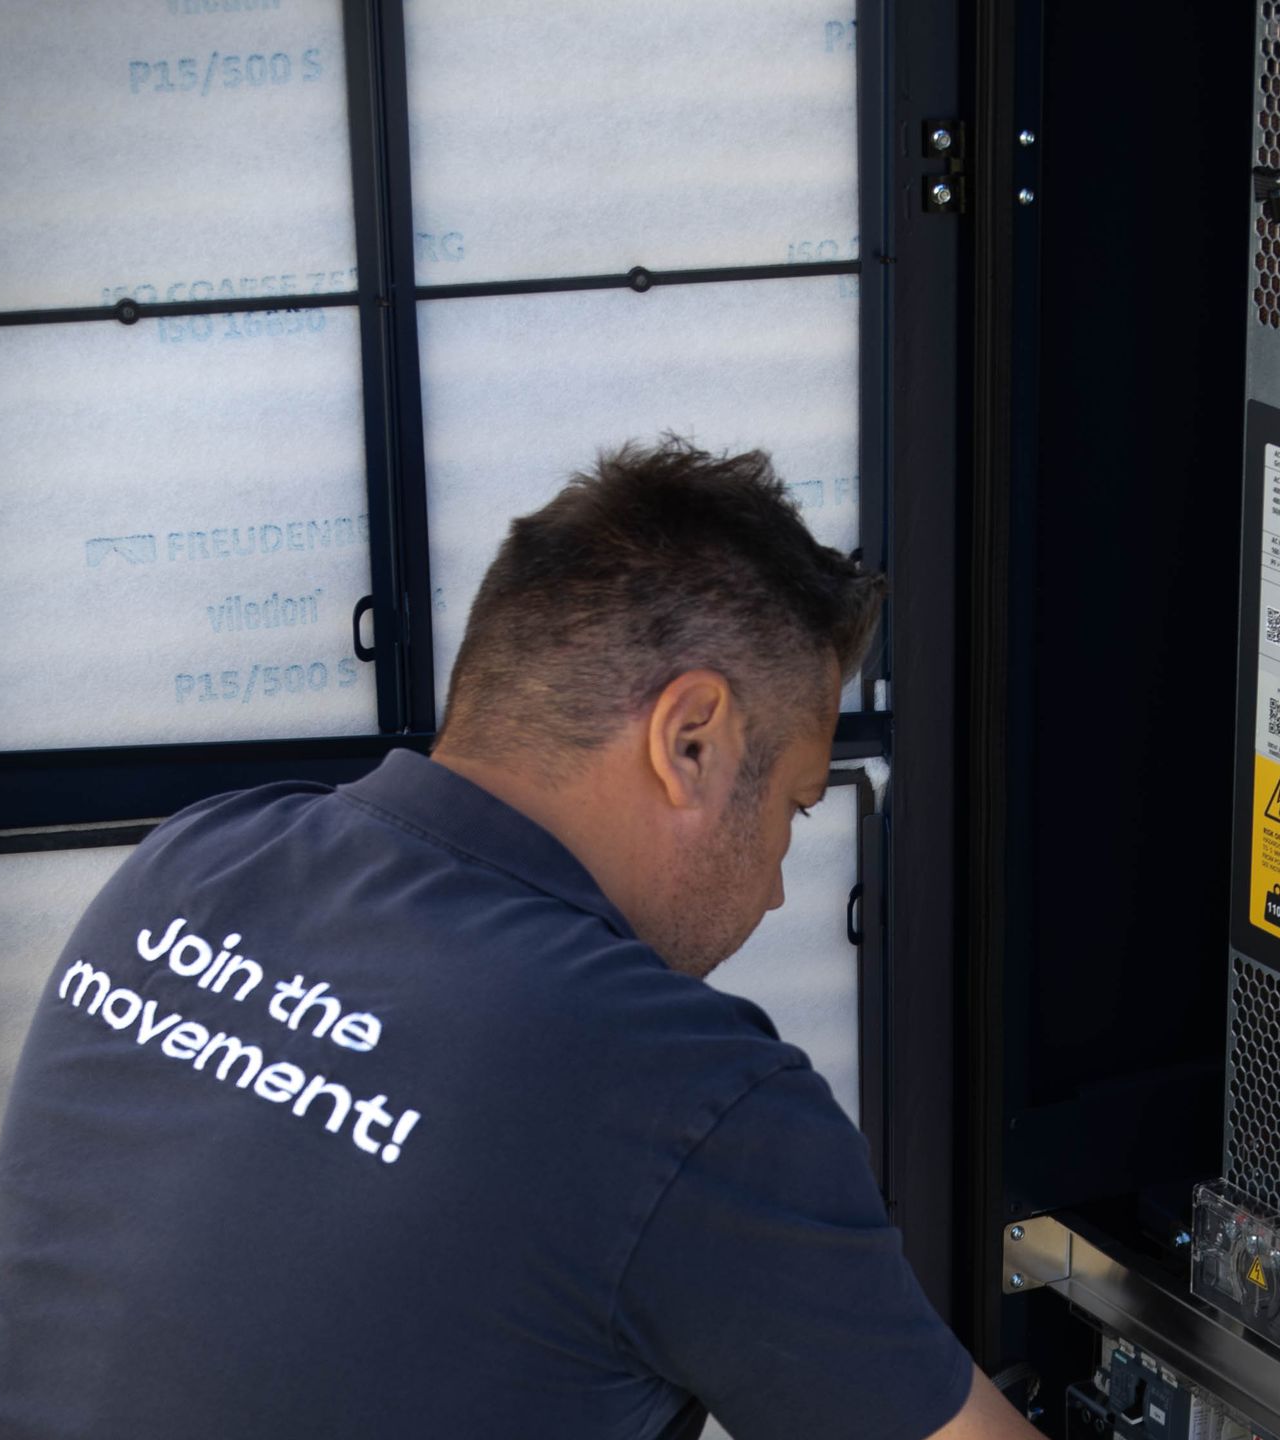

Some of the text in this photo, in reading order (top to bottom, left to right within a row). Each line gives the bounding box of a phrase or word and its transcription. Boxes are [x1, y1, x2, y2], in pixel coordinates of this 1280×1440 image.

[128, 49, 322, 97] P15/500 S
[174, 657, 358, 704] P15/500 S
[136, 918, 382, 1051] Join the
[58, 960, 420, 1163] movement!
